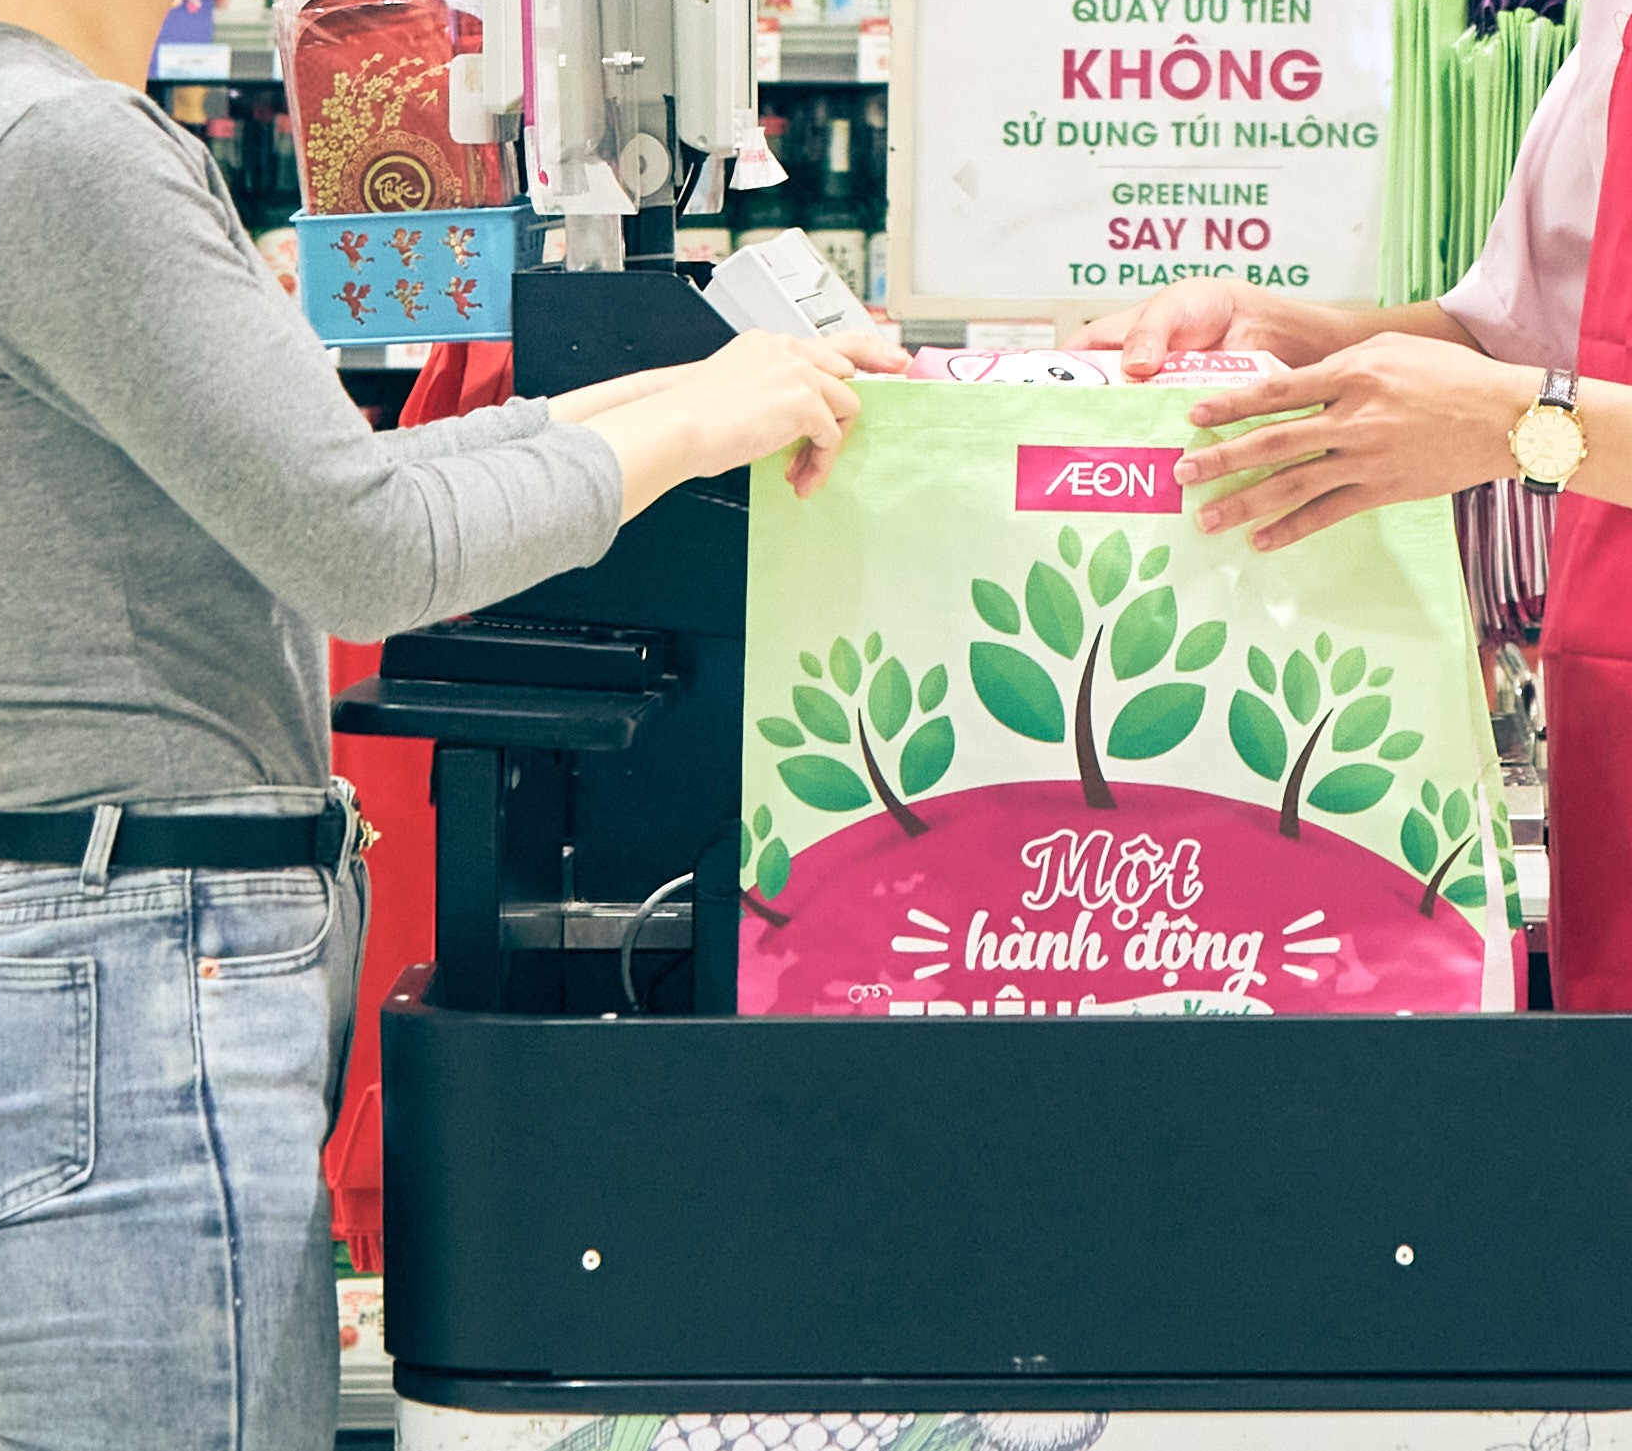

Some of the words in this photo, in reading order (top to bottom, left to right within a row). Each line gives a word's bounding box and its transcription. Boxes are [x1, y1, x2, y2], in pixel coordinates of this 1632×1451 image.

[1062, 33, 1323, 102] KHÔNG
[1002, 110, 1047, 148] SỬ
[1055, 121, 1159, 156] DỤNG
[1170, 113, 1221, 148] TÚI
[1233, 114, 1380, 149] NI-LÔNG
[1111, 182, 1270, 207] GREENLINE
[1108, 216, 1188, 252] SAY
[1204, 216, 1273, 253] NO
[1069, 262, 1108, 287] TO
[1245, 263, 1311, 287] BAG
[1162, 358, 1253, 372] OPVALU
[1021, 827, 1206, 929] Một
[963, 912, 1110, 973] hành
[1122, 912, 1266, 996] động
